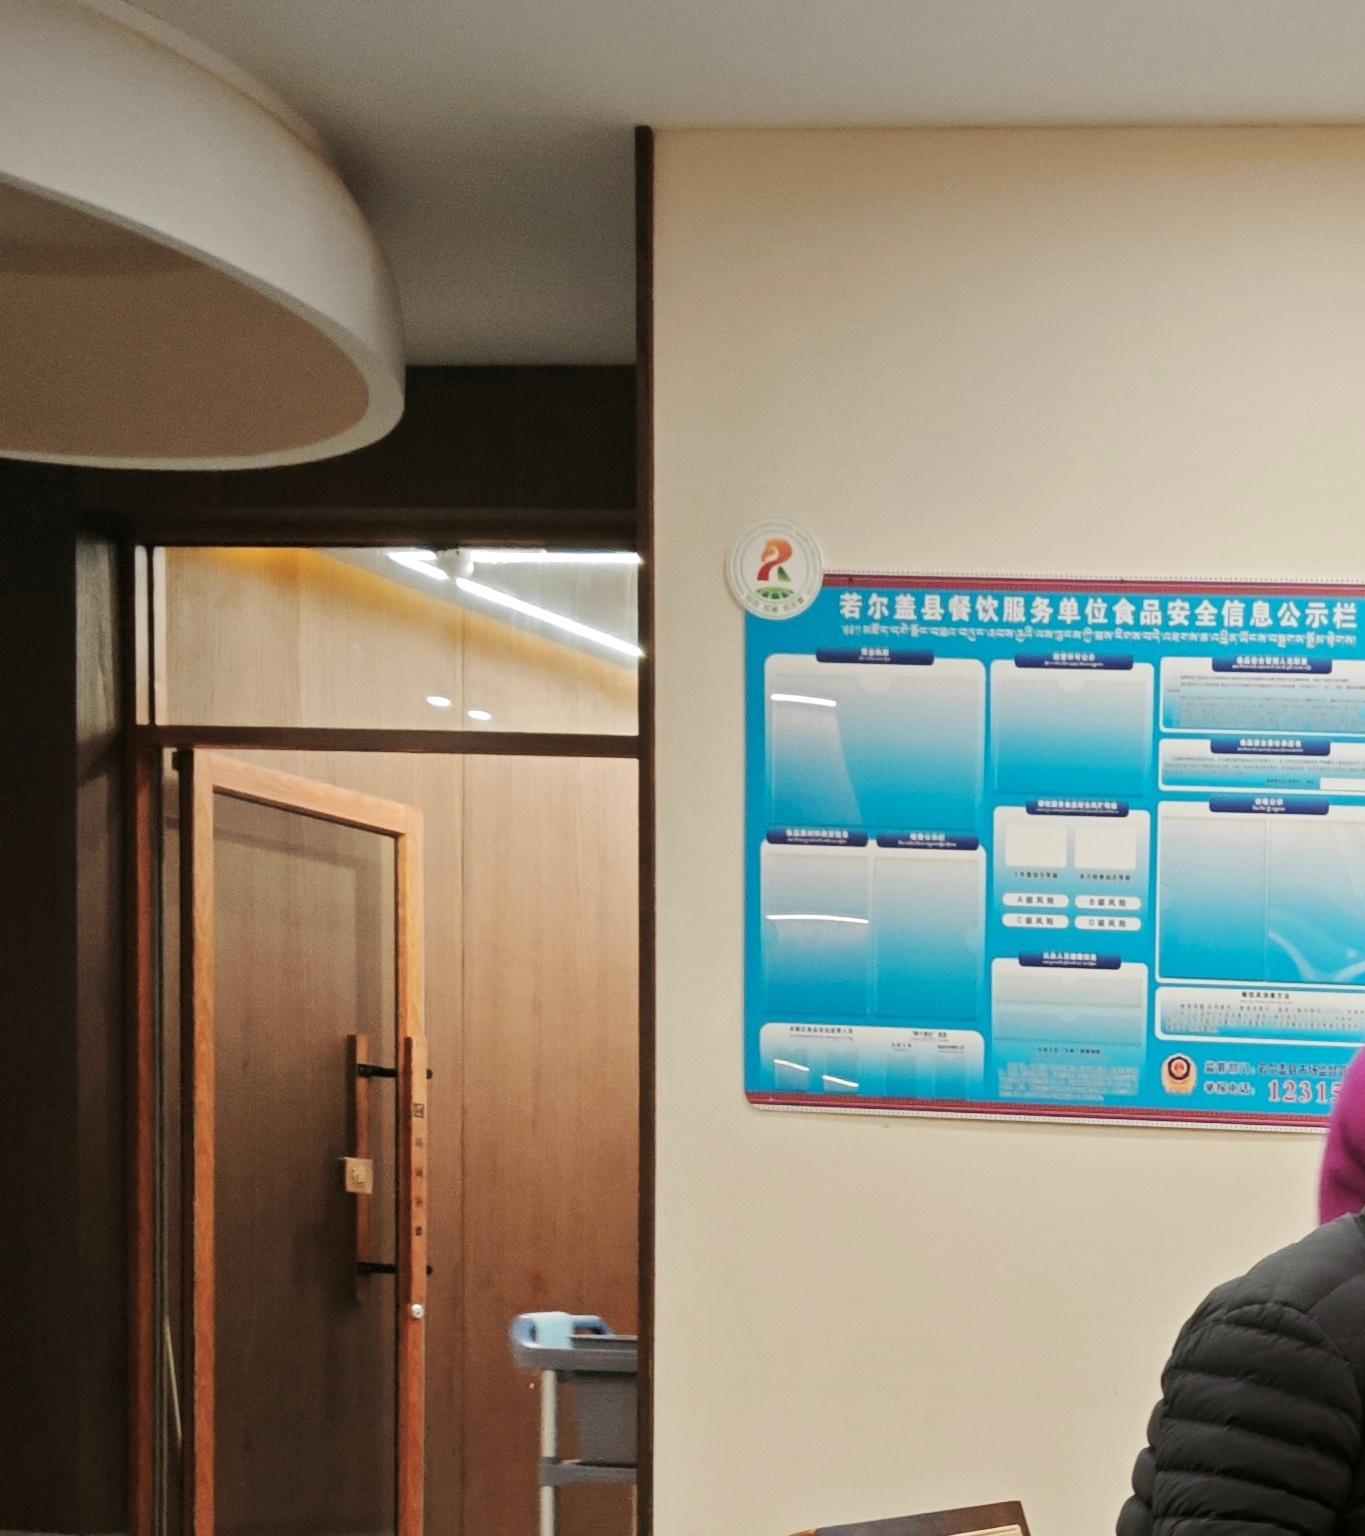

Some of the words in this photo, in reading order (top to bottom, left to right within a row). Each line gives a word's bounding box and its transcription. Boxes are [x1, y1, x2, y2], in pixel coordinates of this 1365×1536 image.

[839, 592, 1358, 629] 若尔盖县餐饮服务单位食品安全信息公示栏
